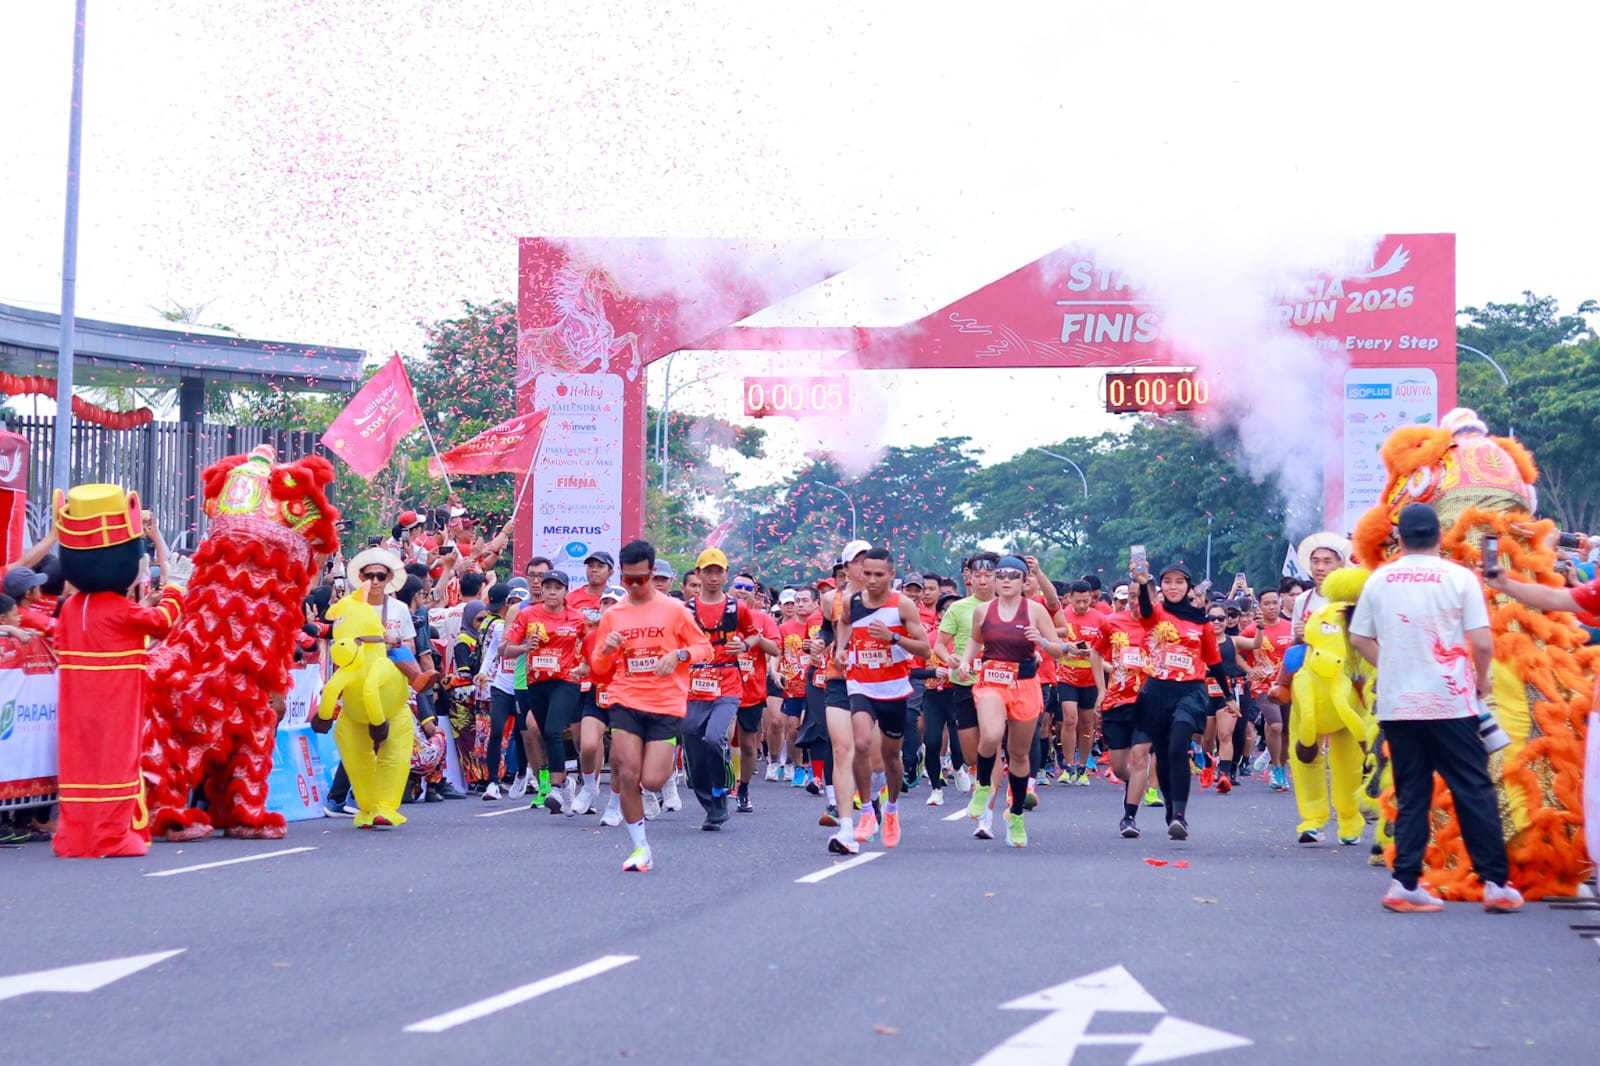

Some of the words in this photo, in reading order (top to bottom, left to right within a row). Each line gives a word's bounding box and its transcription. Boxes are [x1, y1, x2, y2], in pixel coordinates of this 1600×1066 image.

[1278, 300, 1338, 328] RUN
[1345, 285, 1416, 314] 2026
[1060, 311, 1164, 344] FINIS
[1345, 335, 1393, 352] Every
[1398, 334, 1440, 351] Step
[748, 383, 845, 411] 0:00:05
[1108, 377, 1209, 407] 0:00:00
[1349, 387, 1390, 398] ISOPLUS
[1395, 385, 1432, 397] AQUVIVA
[571, 423, 597, 431] inves
[556, 477, 598, 488] FINNA
[542, 525, 603, 535] MERATUS
[1386, 573, 1443, 584] OFFICIAL
[630, 658, 656, 668] 13459
[987, 671, 1011, 680] 11004
[17, 703, 57, 722] PARAH
